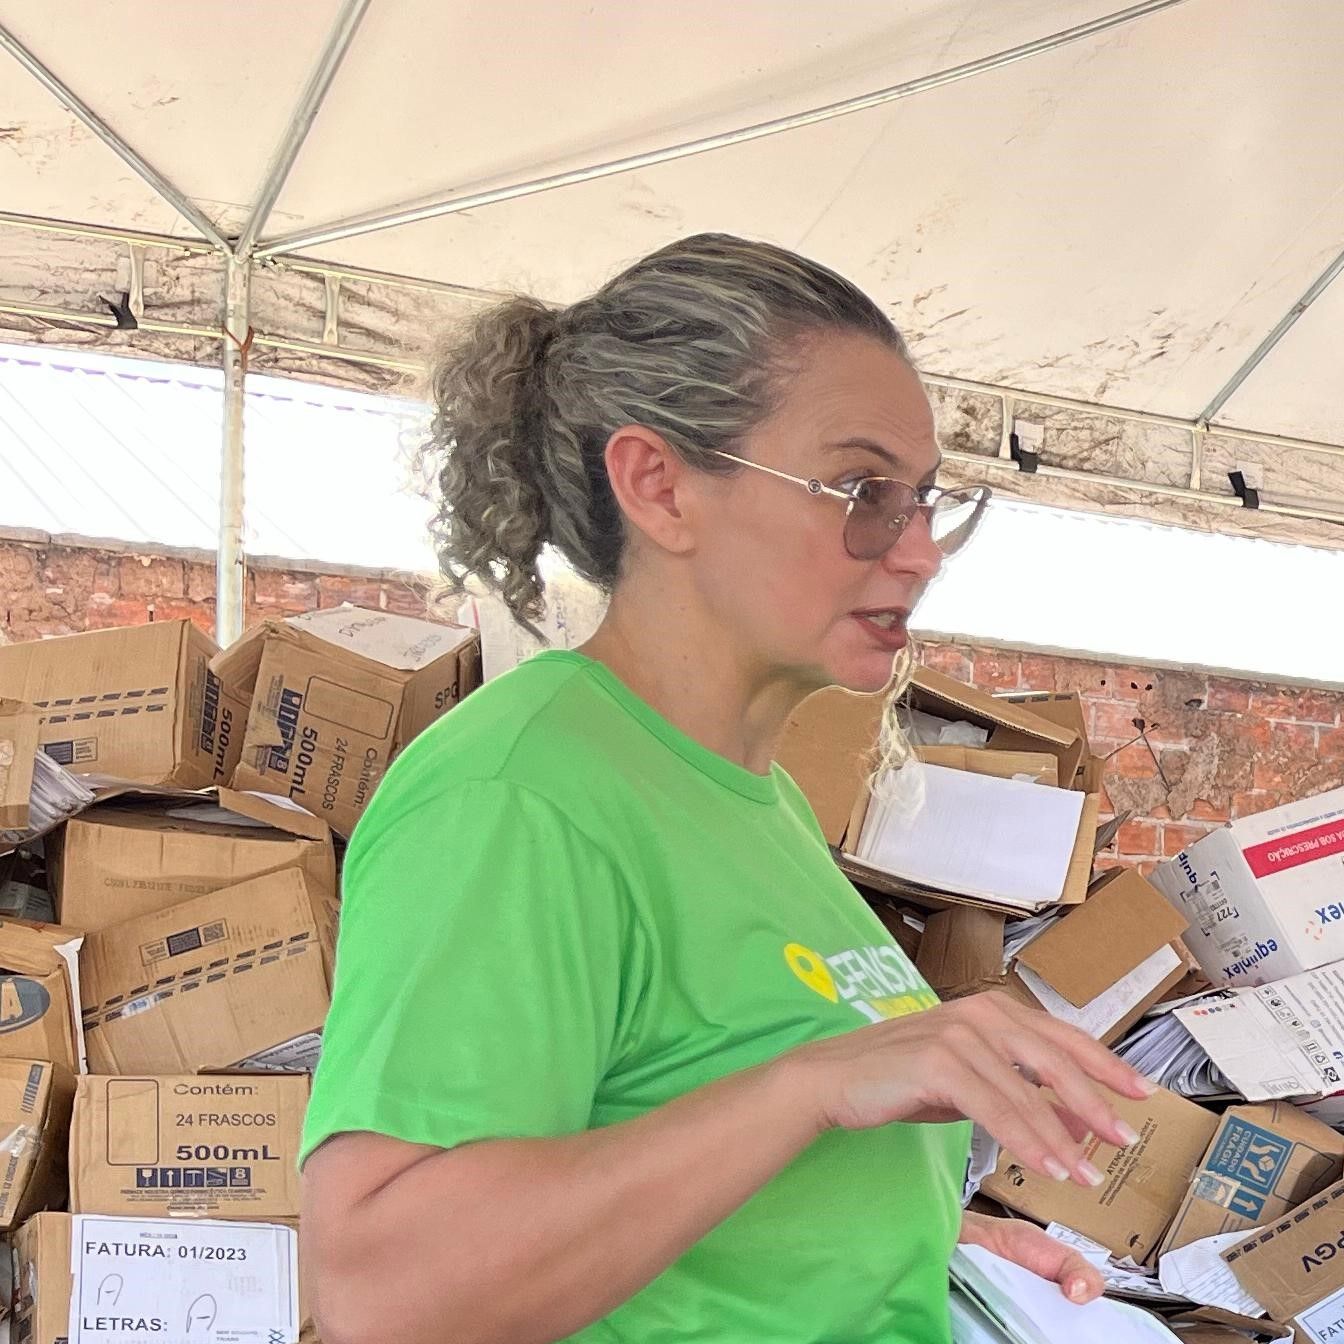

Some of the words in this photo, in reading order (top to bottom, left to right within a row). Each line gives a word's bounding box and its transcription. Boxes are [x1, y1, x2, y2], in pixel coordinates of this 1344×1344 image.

[214, 707, 232, 780] 500mL
[336, 737, 347, 754] 24
[289, 726, 318, 798] 500mL
[322, 753, 345, 811] FRASCOS
[1317, 832, 1336, 846] SOB
[1267, 837, 1318, 863] PRESCRIÇÃO
[173, 1083, 259, 1096] Contém:
[176, 1114, 194, 1127] 24
[199, 1114, 276, 1127] FRASCOS
[176, 1145, 280, 1161] 500mL
[85, 1242, 171, 1258] FATURA:
[178, 1246, 247, 1261] 01/2023
[83, 1317, 168, 1331] LETRAS:
